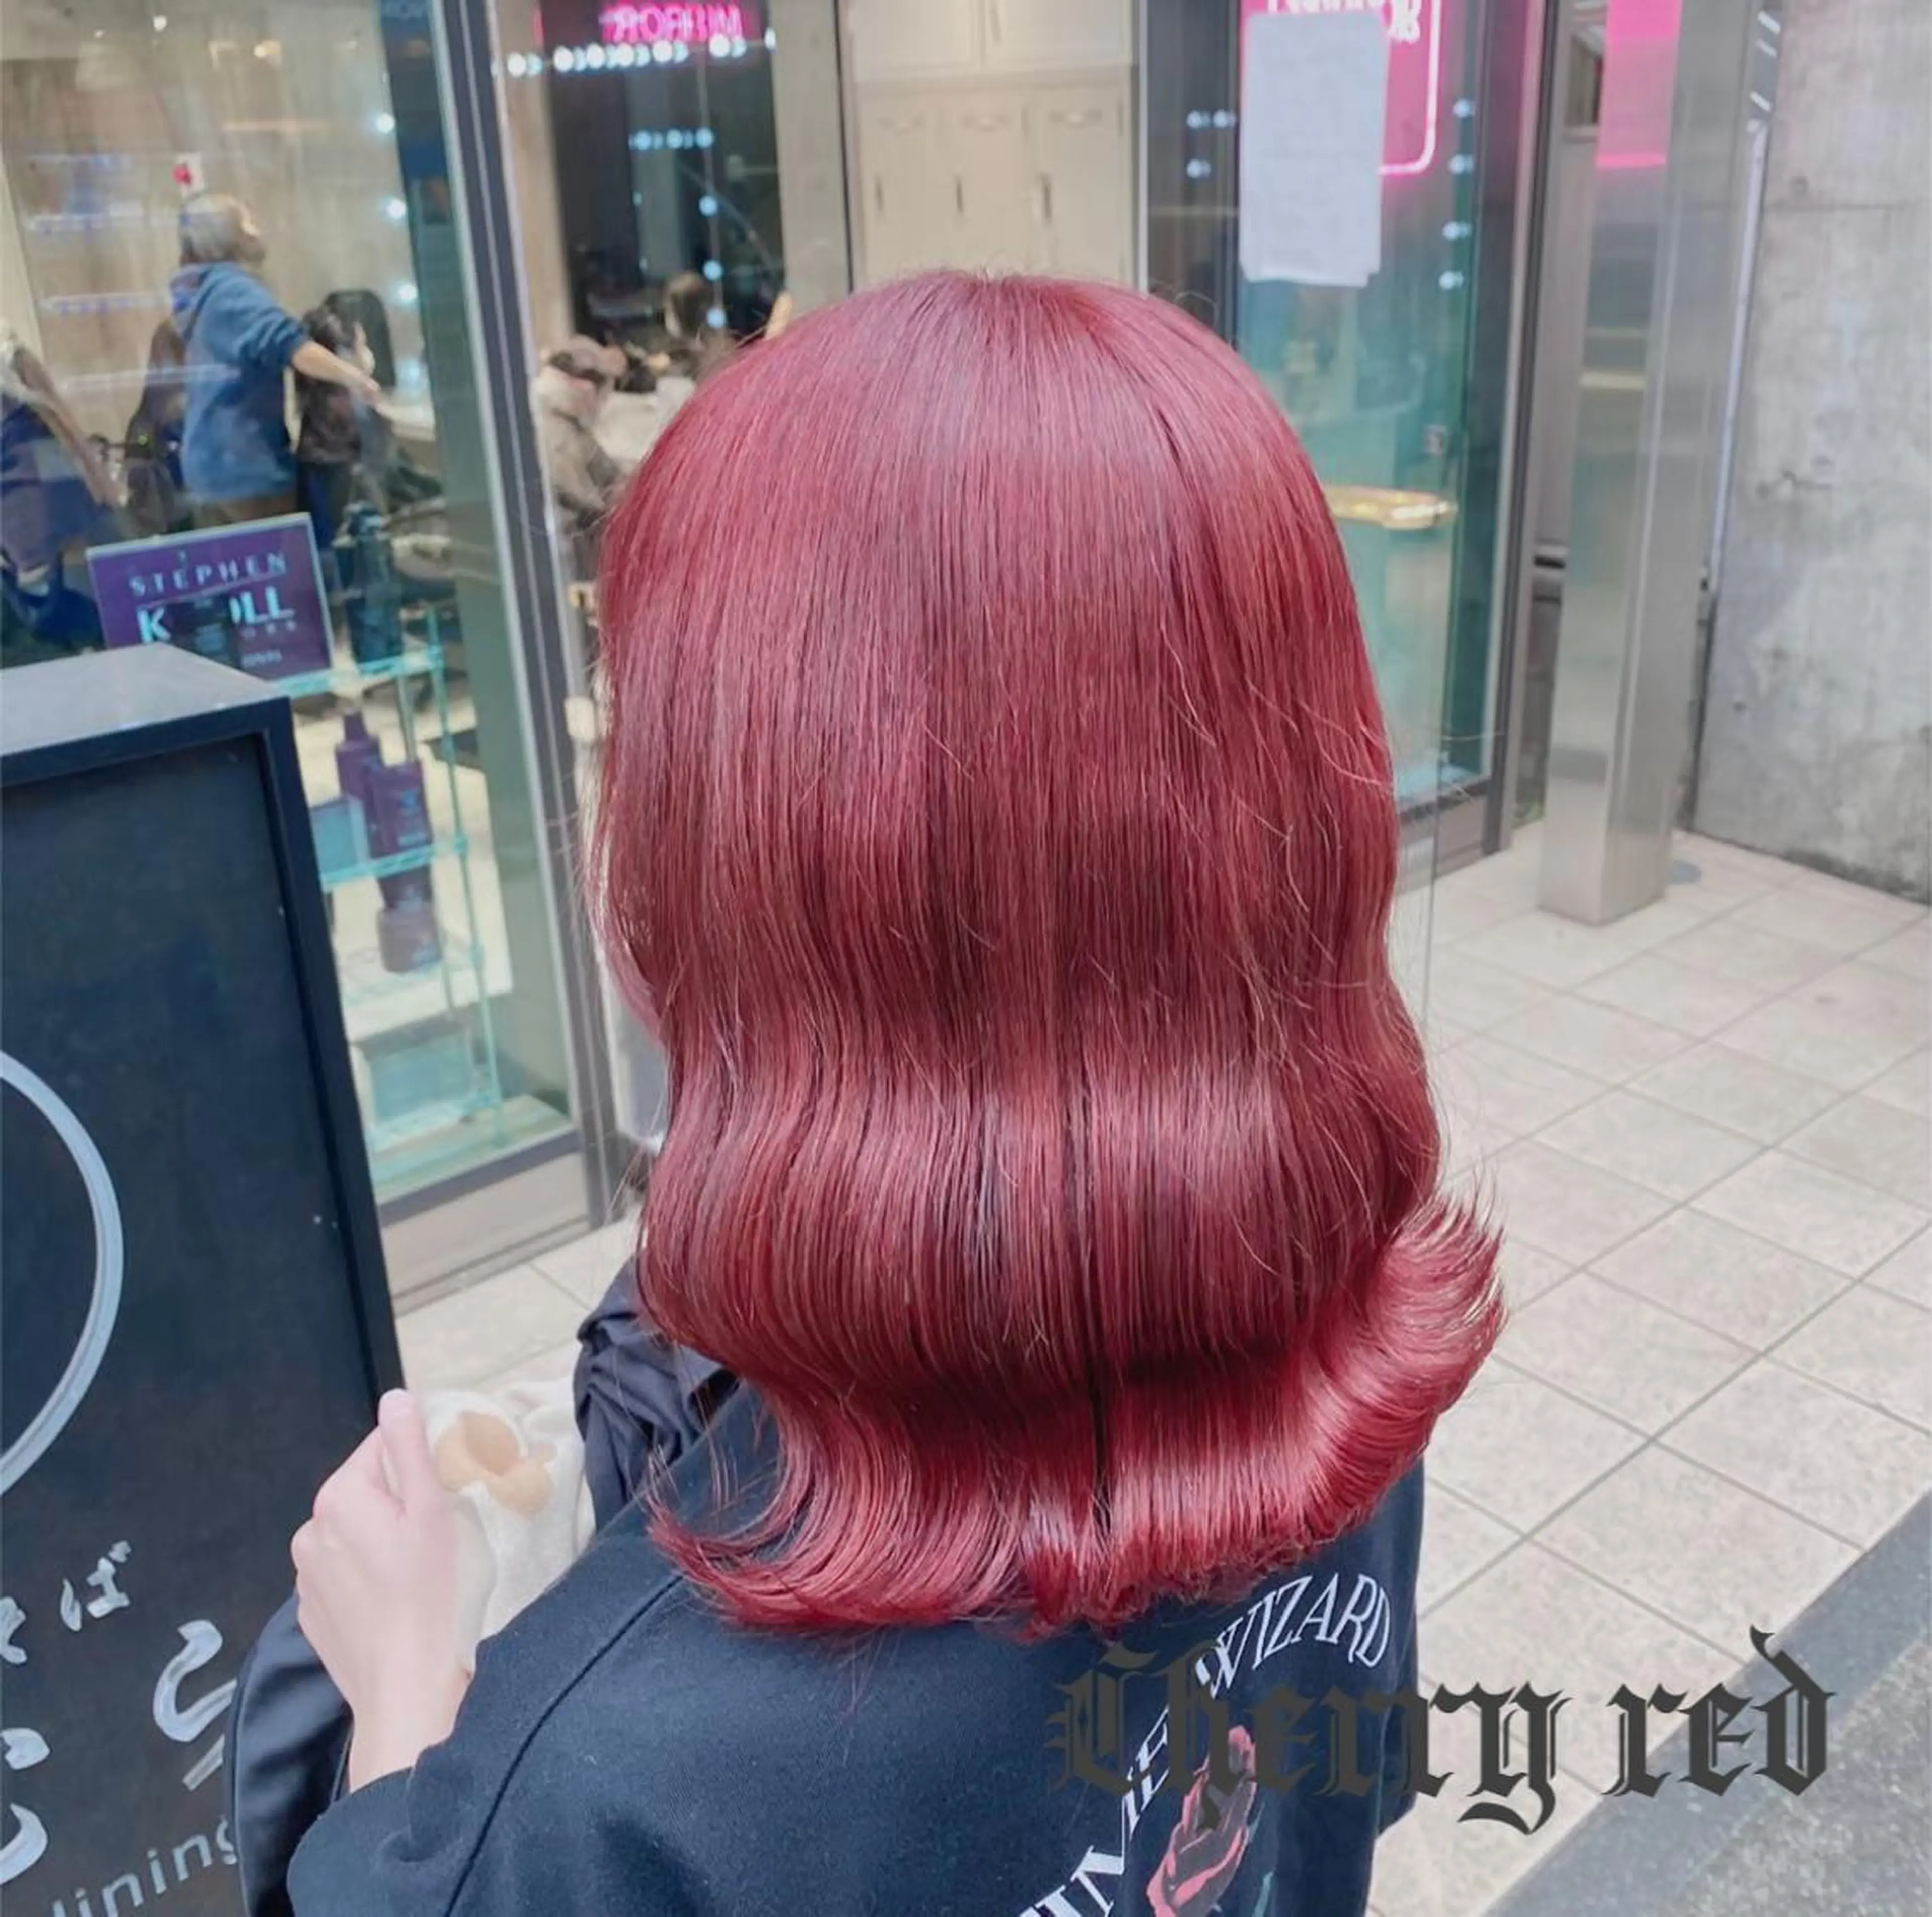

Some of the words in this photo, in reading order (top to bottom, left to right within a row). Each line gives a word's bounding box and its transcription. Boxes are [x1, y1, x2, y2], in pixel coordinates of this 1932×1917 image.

[129, 551, 286, 597] STEPHEN
[136, 586, 295, 644] KLL
[1195, 1572, 1391, 1699] WIZARD
